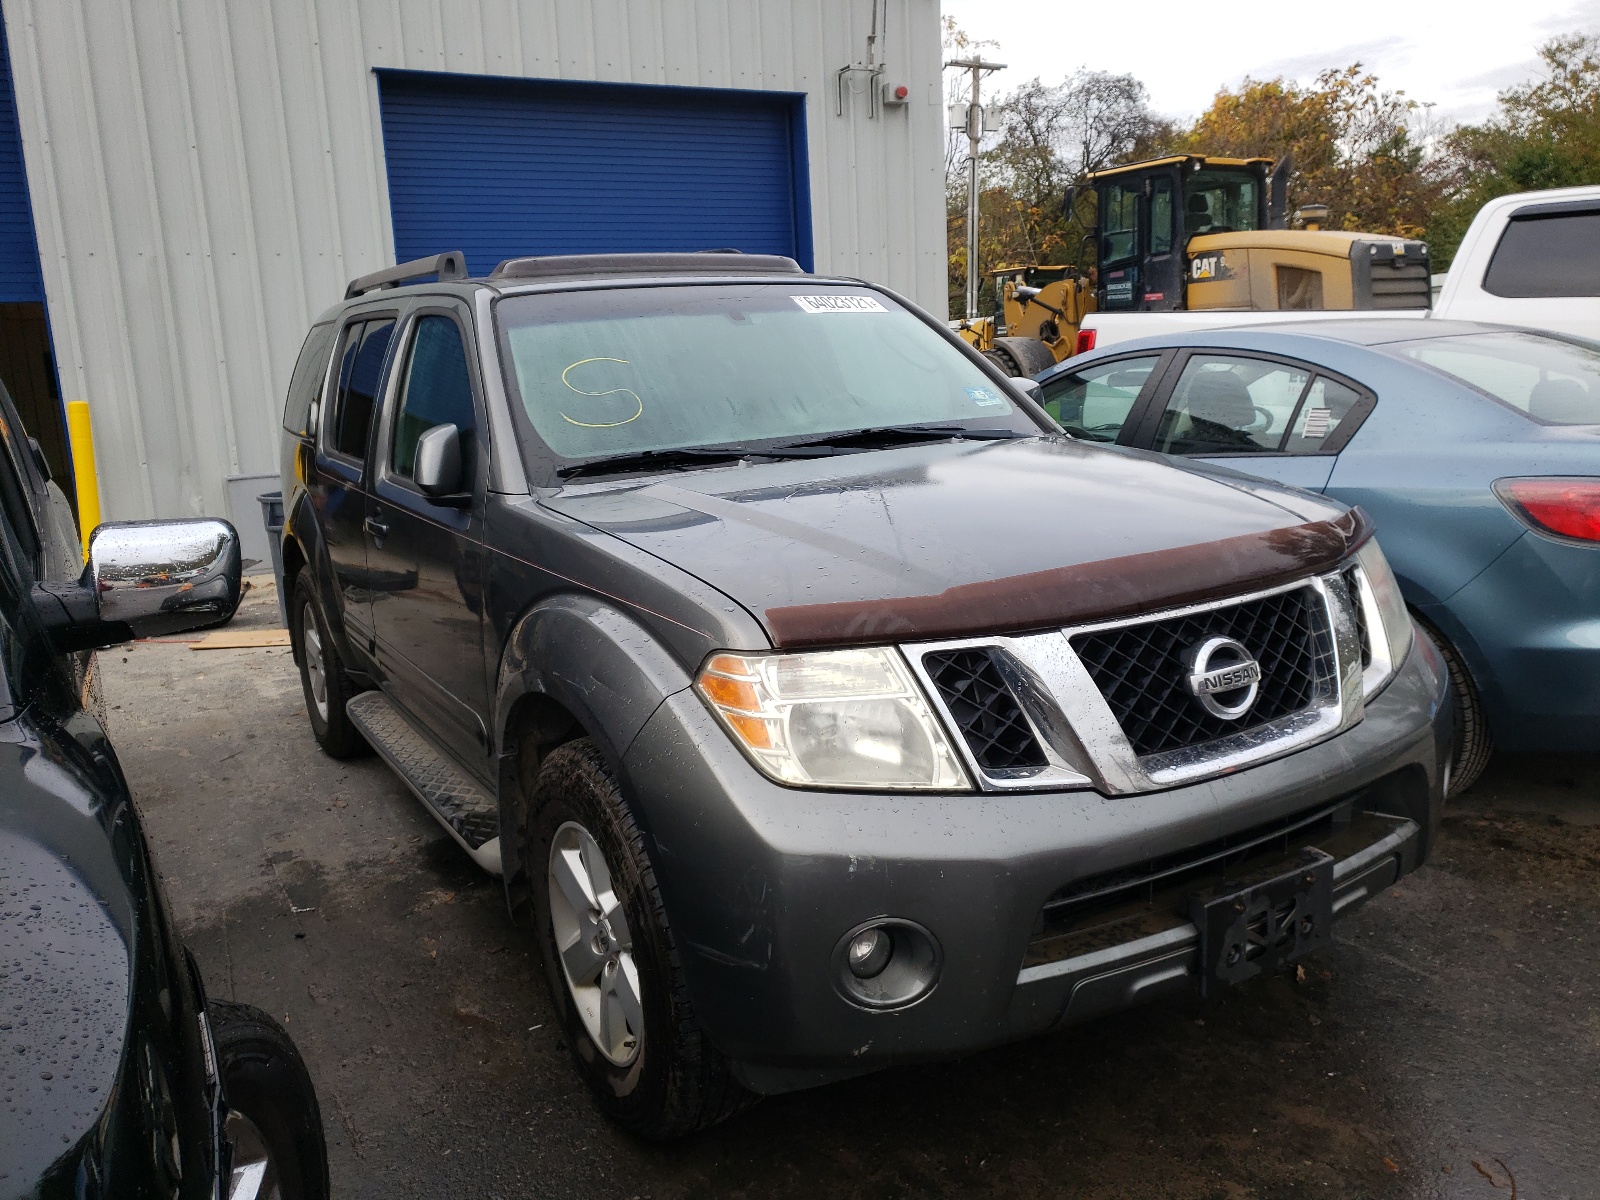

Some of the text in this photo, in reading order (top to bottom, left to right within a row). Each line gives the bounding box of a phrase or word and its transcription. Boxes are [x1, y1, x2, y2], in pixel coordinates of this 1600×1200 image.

[1192, 257, 1217, 279] CAT
[802, 296, 874, 309] 64023121
[559, 357, 643, 428] S
[1203, 666, 1259, 690] NISSAN
